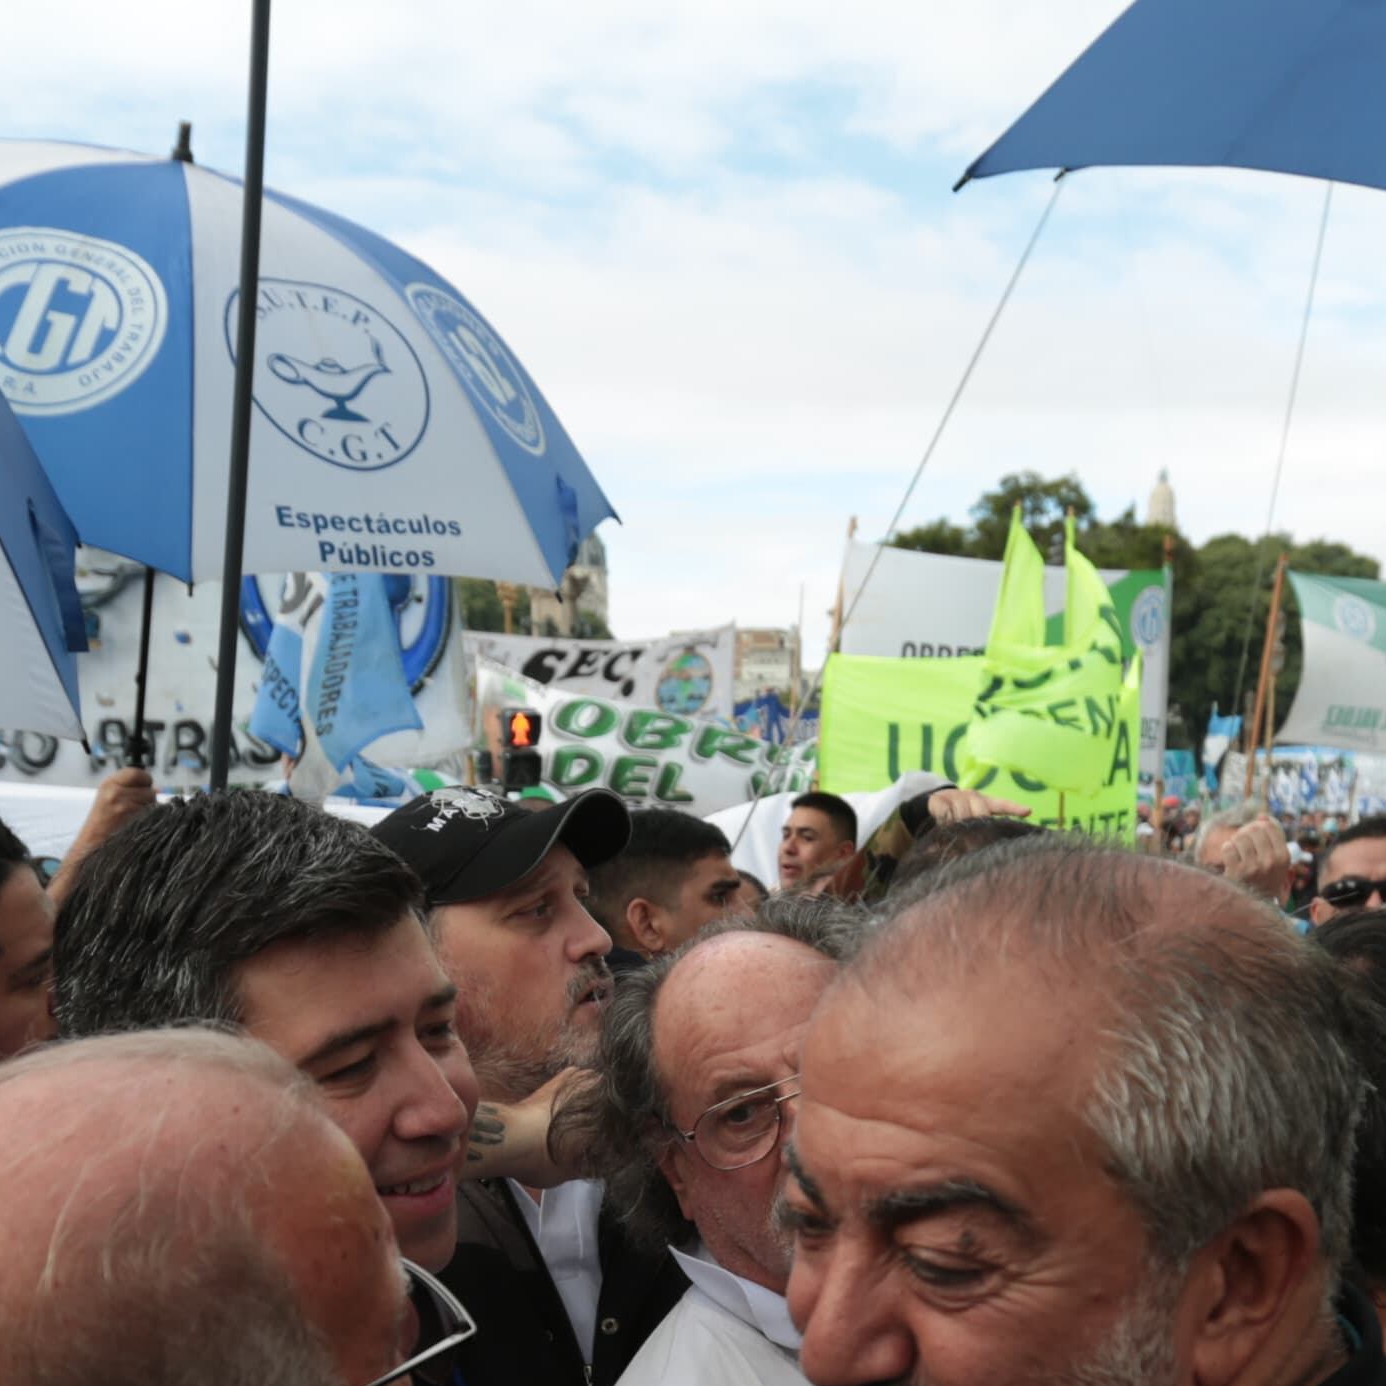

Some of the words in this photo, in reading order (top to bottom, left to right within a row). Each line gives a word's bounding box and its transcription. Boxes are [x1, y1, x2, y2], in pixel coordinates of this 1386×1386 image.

[275, 505, 462, 535] Espectáculos
[318, 541, 436, 568] Públicos
[550, 745, 694, 802] DEL
